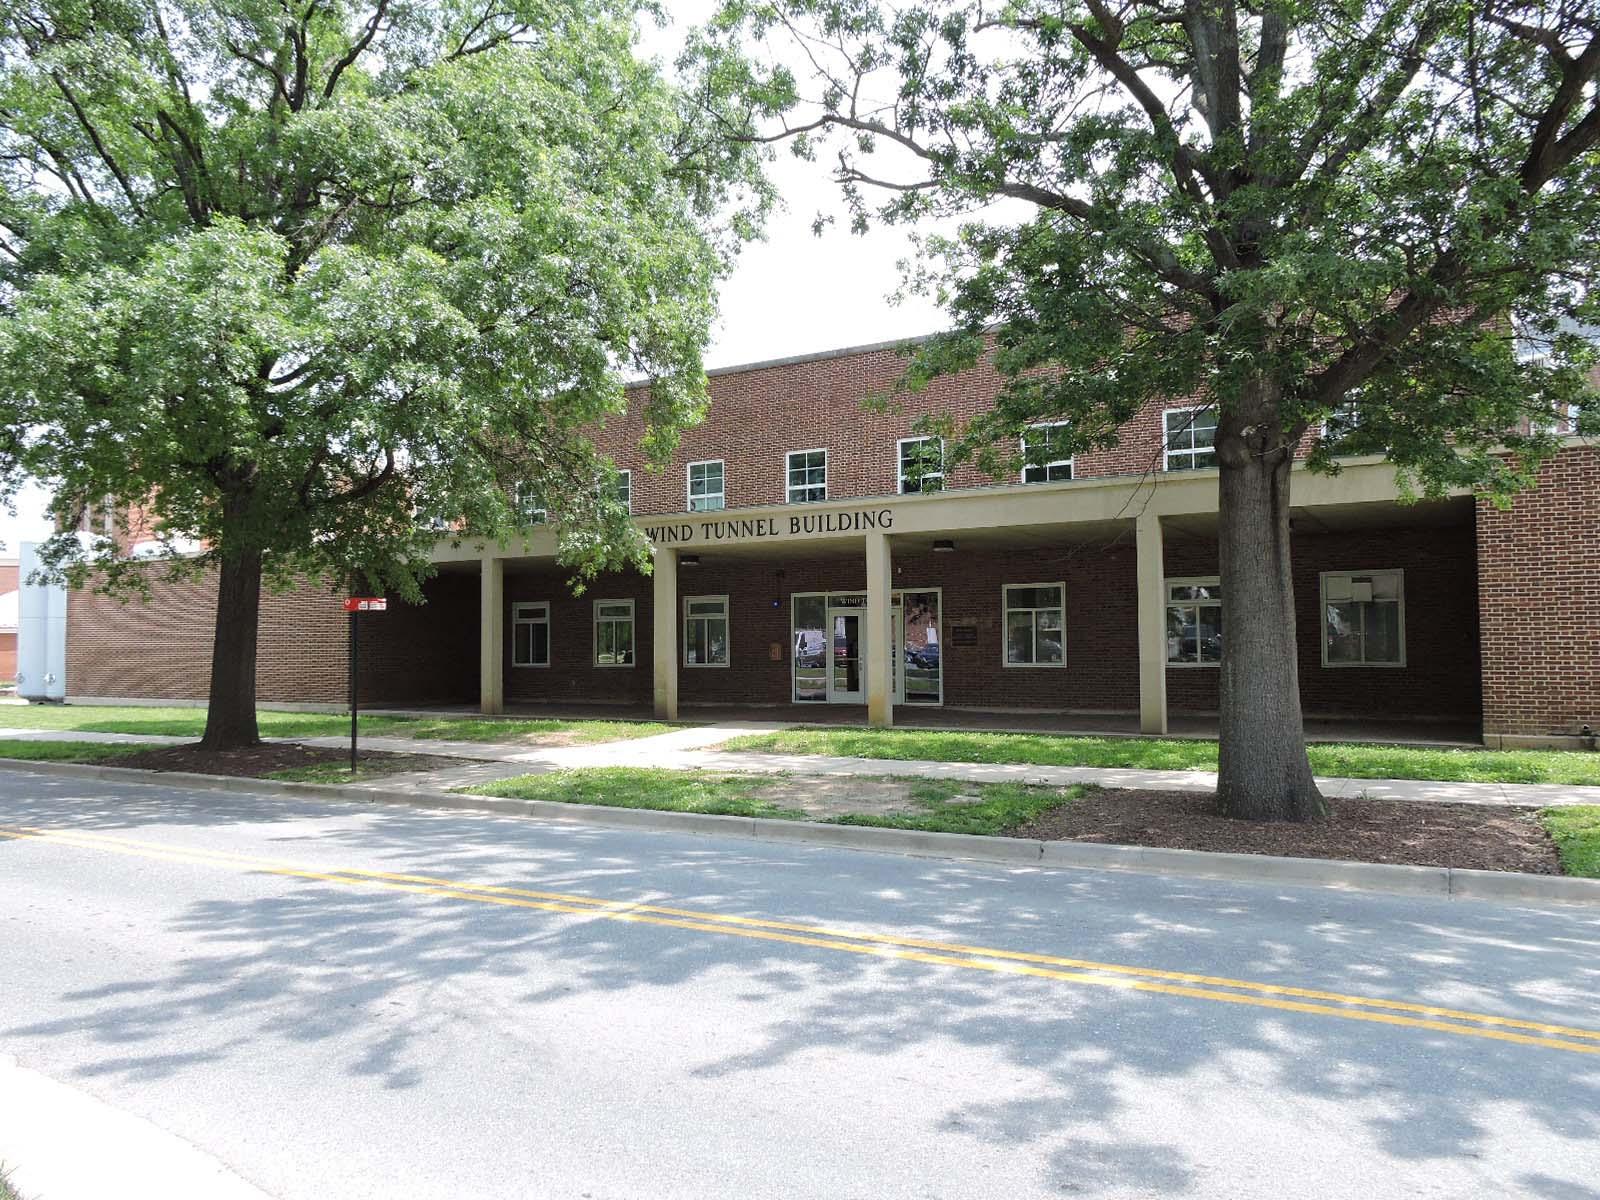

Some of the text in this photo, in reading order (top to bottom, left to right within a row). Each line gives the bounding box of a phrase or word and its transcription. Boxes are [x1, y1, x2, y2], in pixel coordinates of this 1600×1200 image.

[645, 509, 894, 543] WIND TUNNEL BUILDING
